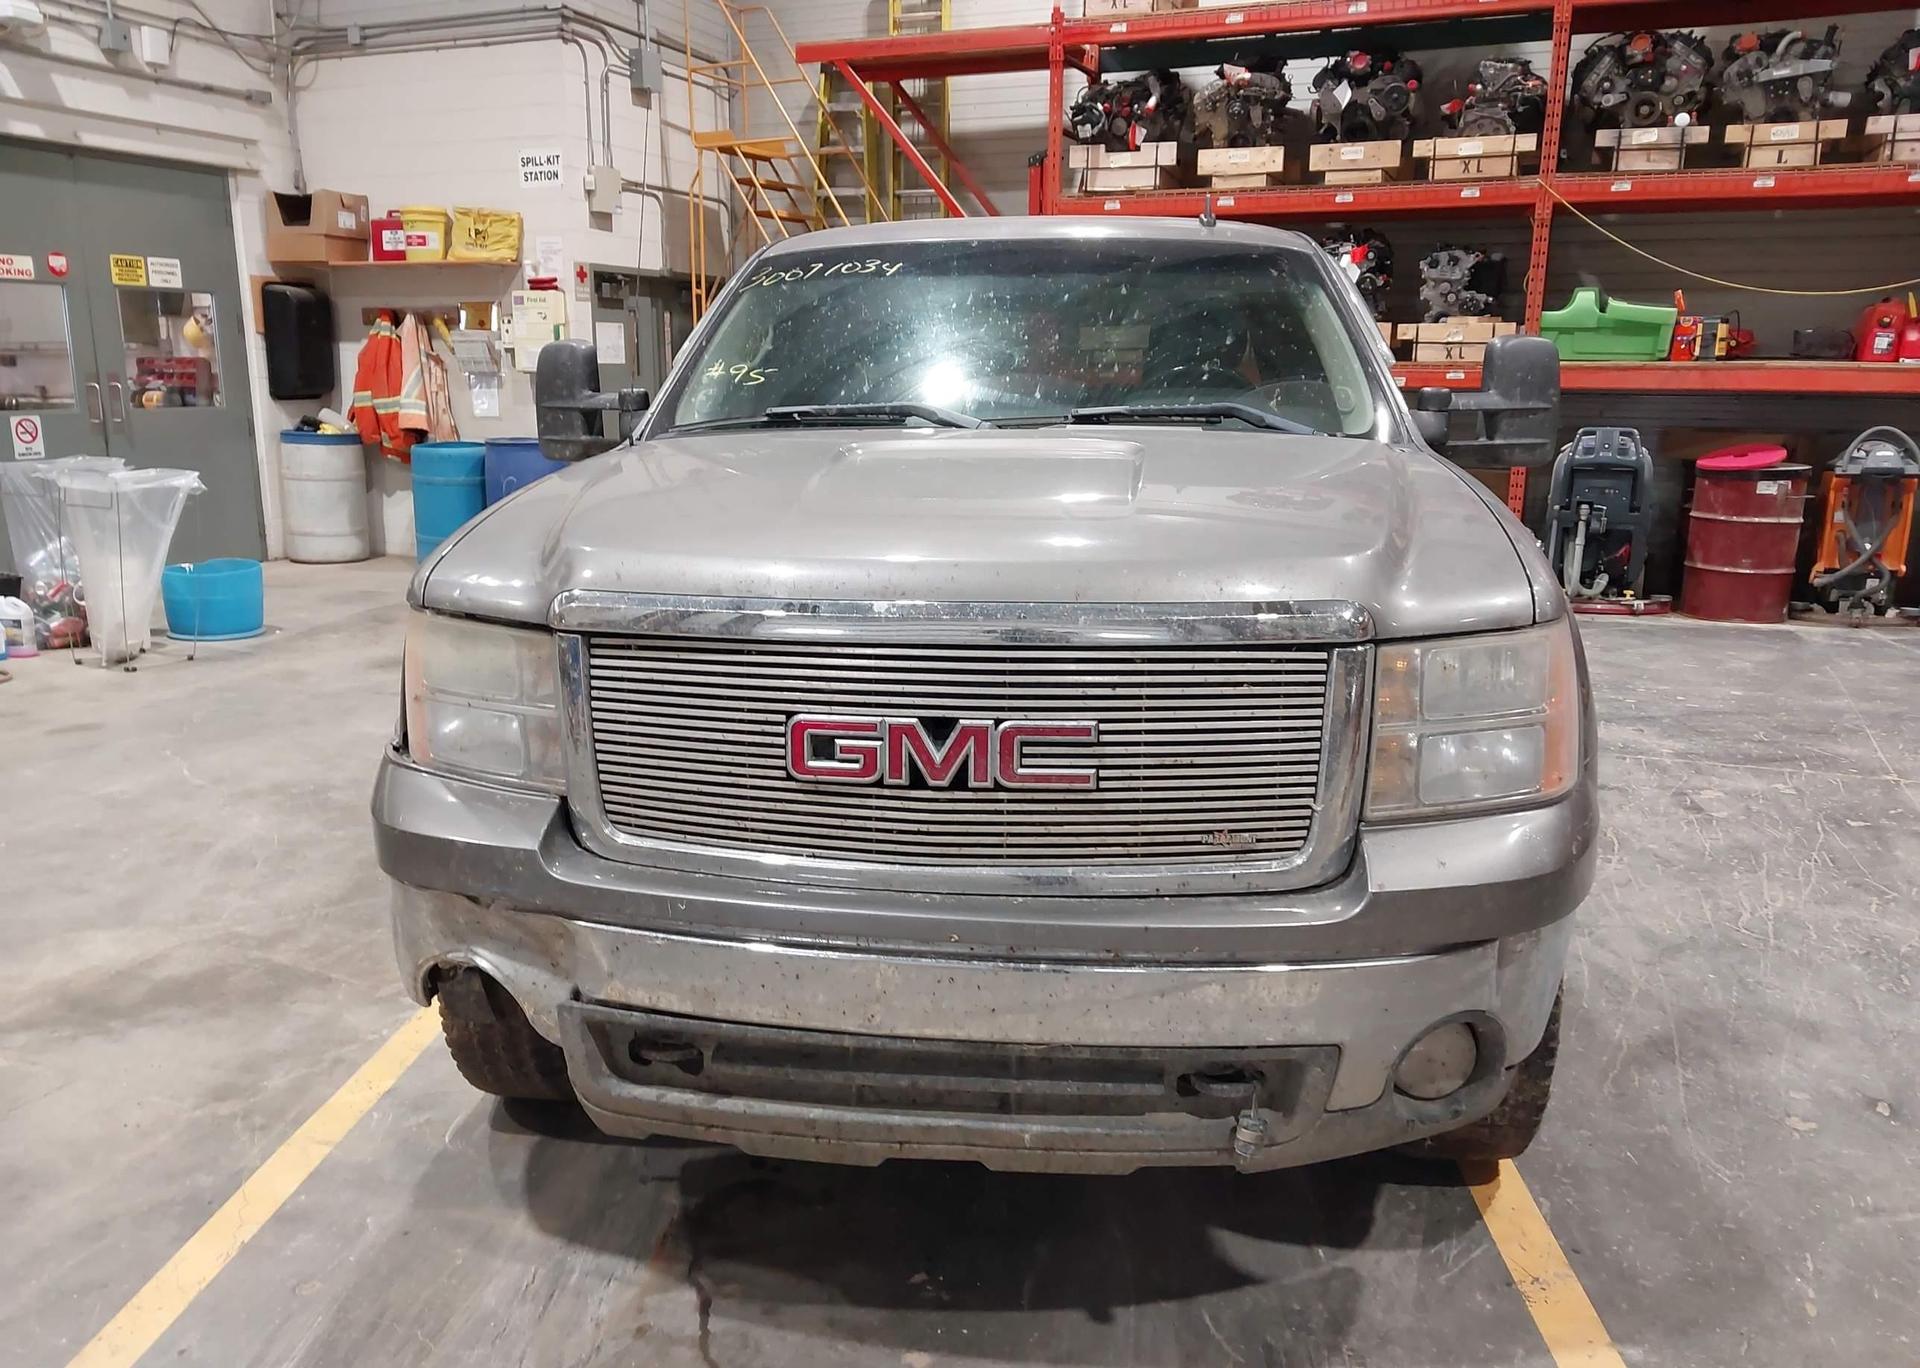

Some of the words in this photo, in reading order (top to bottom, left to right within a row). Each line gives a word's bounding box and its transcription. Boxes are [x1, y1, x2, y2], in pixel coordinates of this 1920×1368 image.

[520, 155, 560, 167] SPILL-KIT
[523, 170, 558, 181] STATION
[0, 257, 14, 265] NO
[113, 258, 142, 269] CAUTION
[706, 359, 778, 385] #95
[786, 714, 1098, 789] GMC
